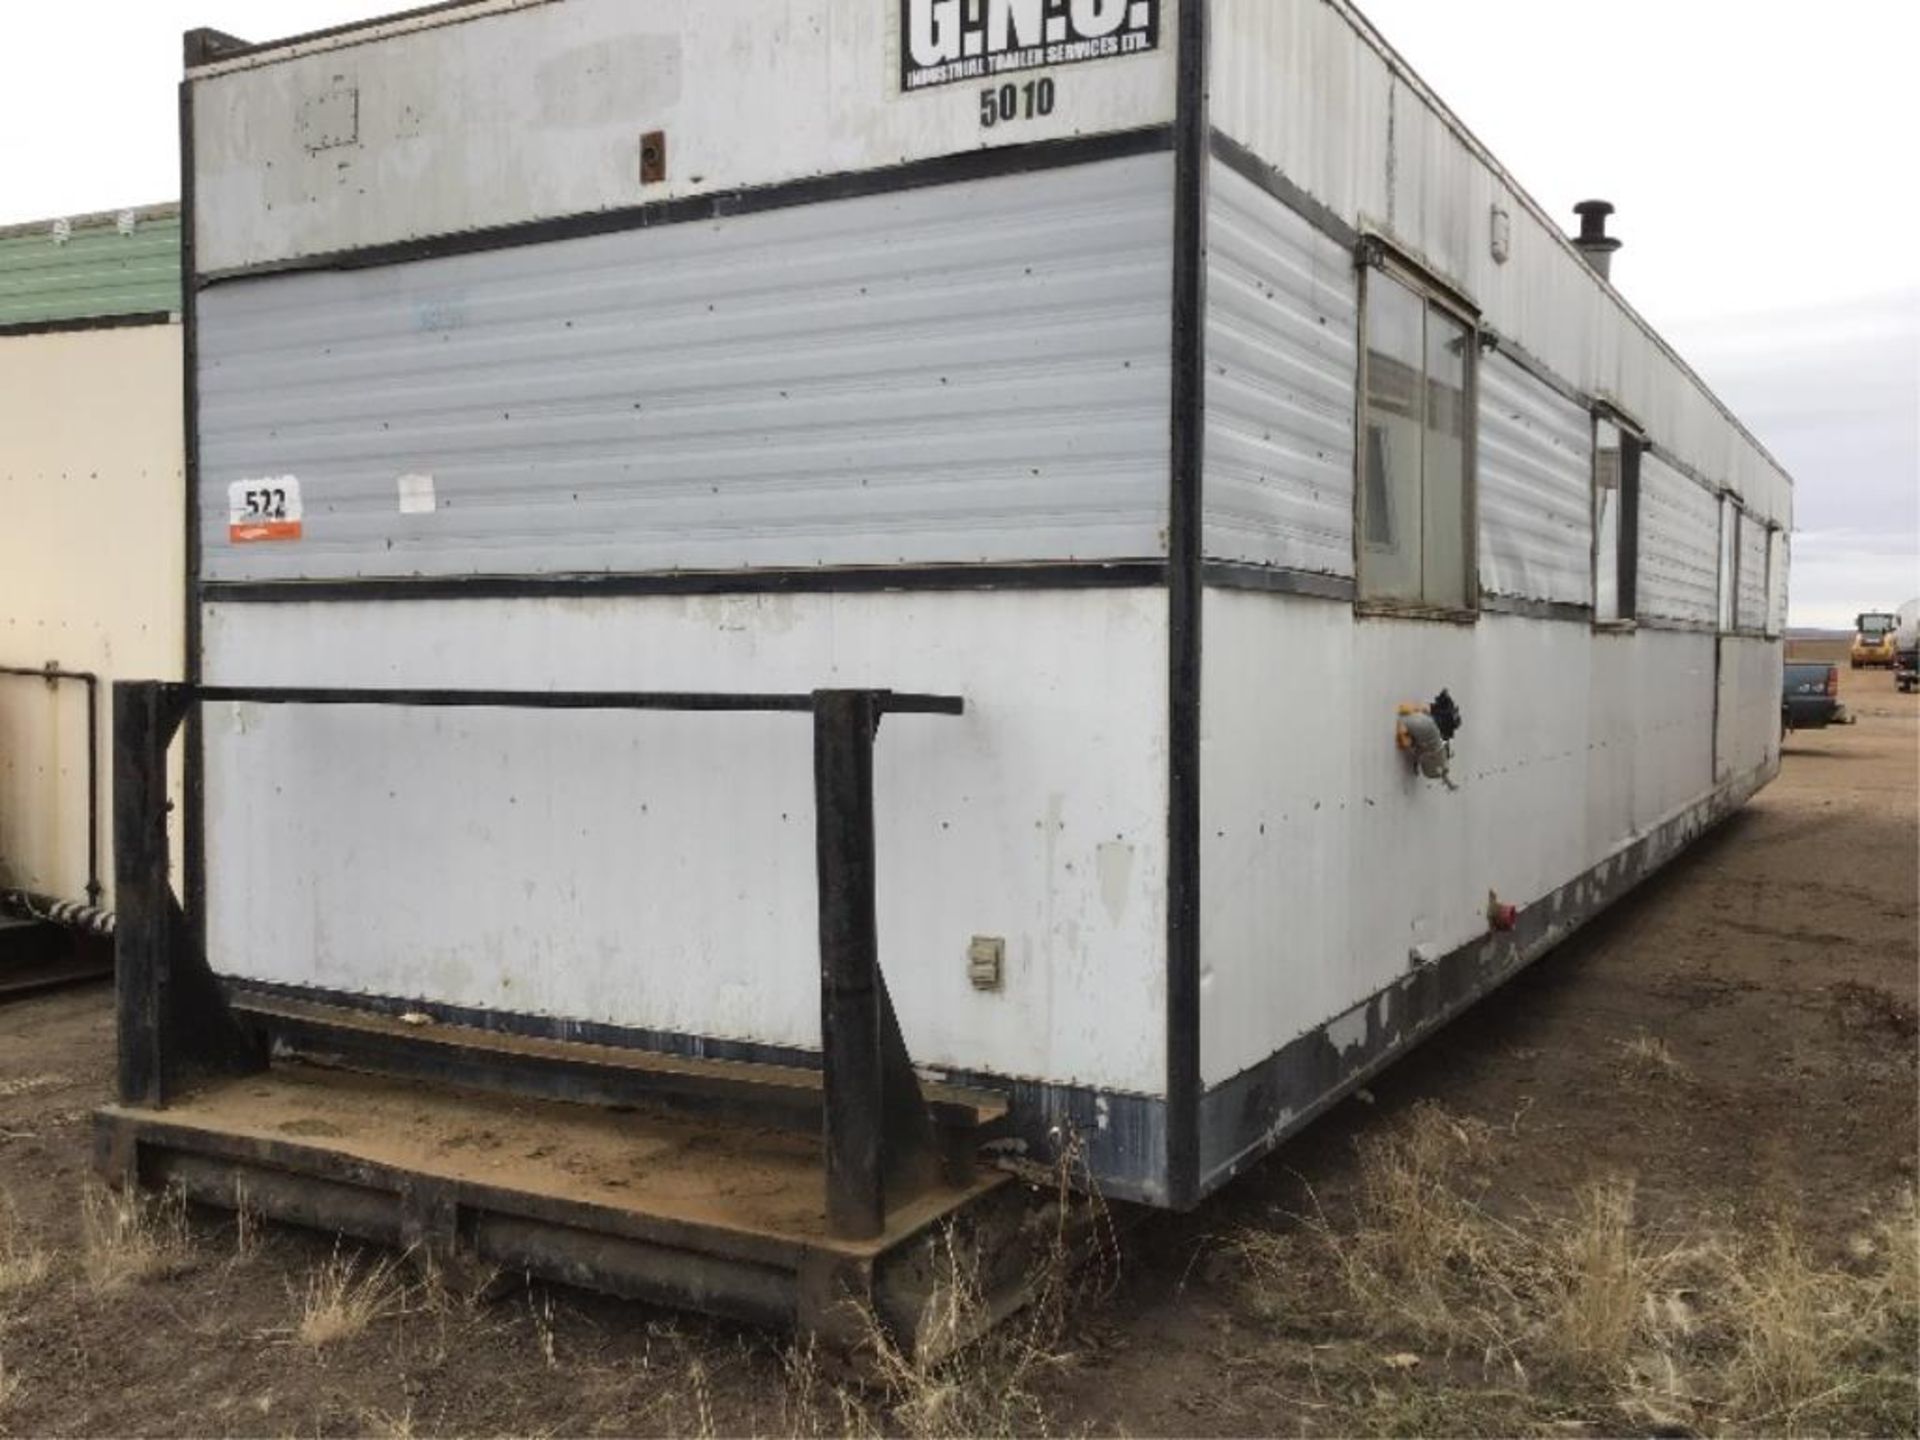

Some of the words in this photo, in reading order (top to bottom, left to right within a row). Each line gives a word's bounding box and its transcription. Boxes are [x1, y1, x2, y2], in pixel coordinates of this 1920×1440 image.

[907, 59, 984, 88] INDUSTRIAL
[989, 48, 1043, 72] TRAILER
[1046, 37, 1118, 63] SERVICES
[980, 77, 1055, 127] 5010
[246, 488, 285, 518] 522
